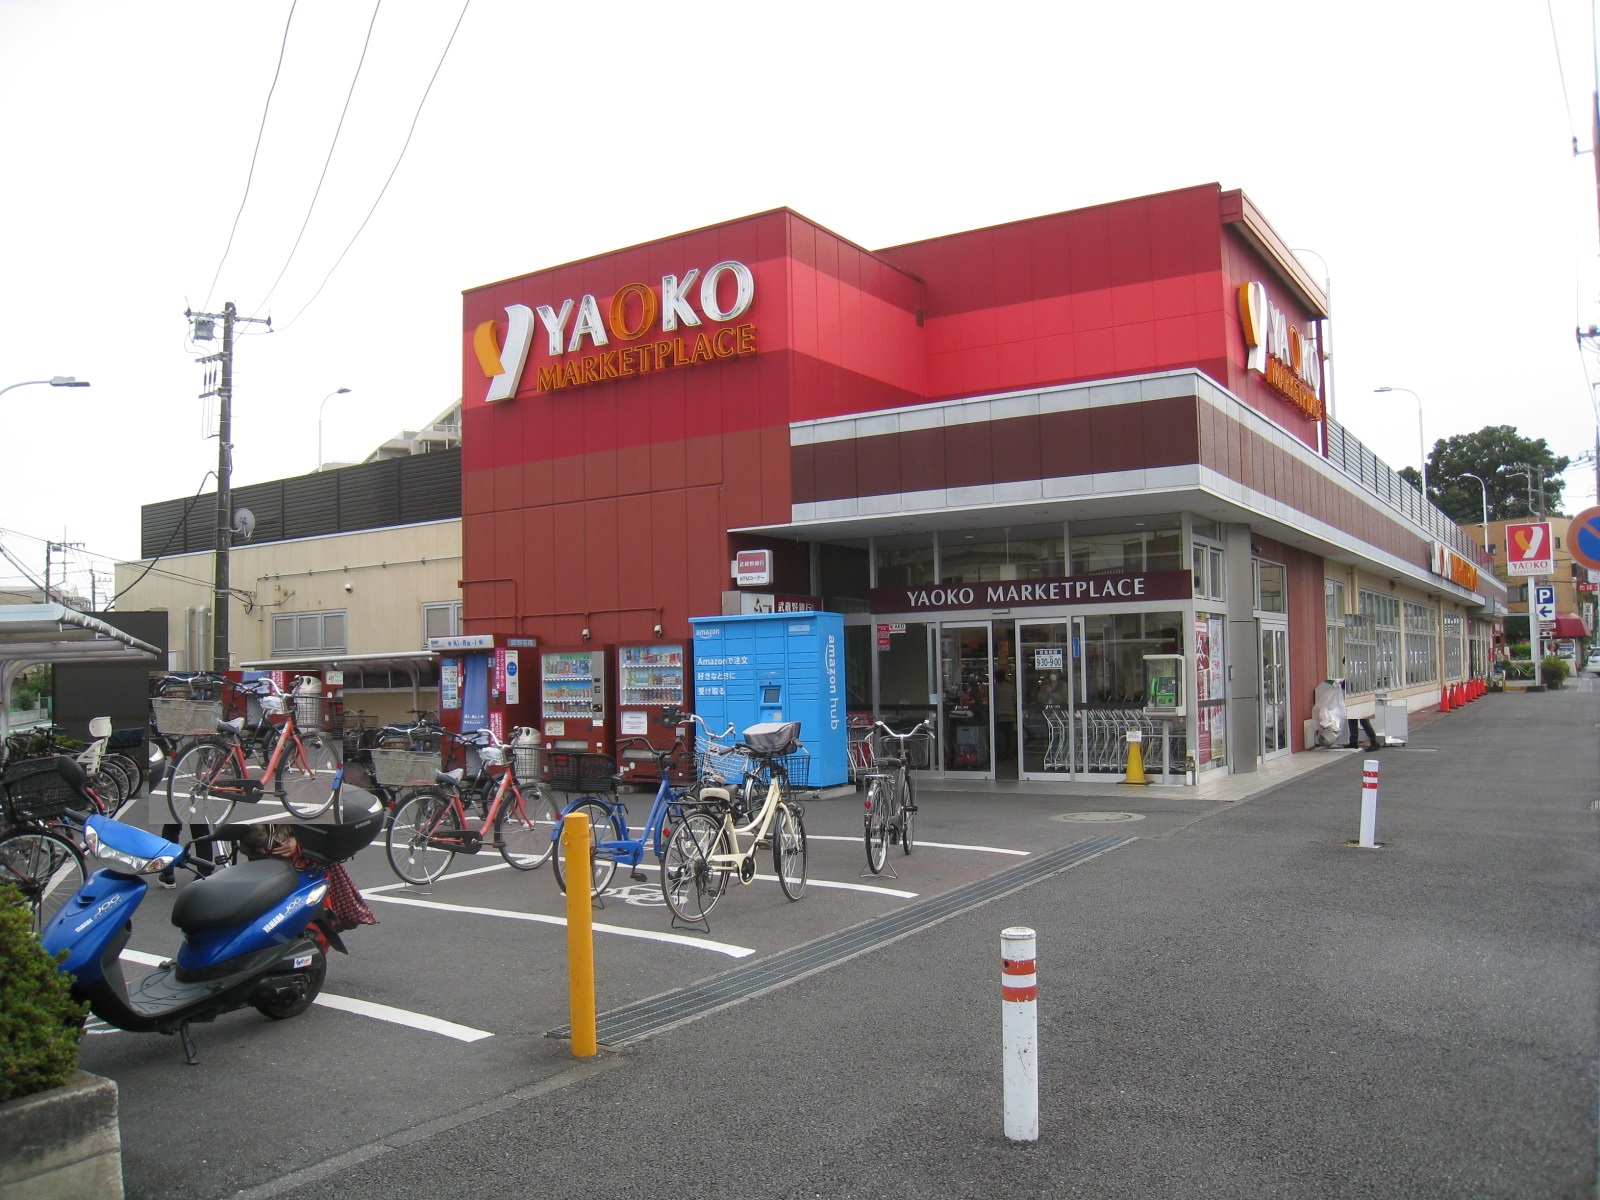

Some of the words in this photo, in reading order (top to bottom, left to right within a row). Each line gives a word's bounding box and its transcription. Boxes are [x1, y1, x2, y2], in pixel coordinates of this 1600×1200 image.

[536, 260, 755, 357] YAOKO
[536, 323, 757, 393] MARKETPLACE
[1511, 560, 1548, 570] YAOKO
[739, 574, 766, 582] ATMコーナー
[906, 587, 975, 607] YAOKO
[986, 577, 1145, 603] MARKETPLACE
[1539, 589, 1551, 604] P
[777, 601, 813, 613] 武蔵野銀行
[695, 628, 720, 637] amazon
[697, 655, 748, 666] Amazonで注文
[826, 634, 837, 694] amazon
[697, 672, 736, 681] 好きなときに
[697, 687, 726, 696] 受け取る
[829, 697, 840, 730] hub
[94, 893, 120, 918] JOG
[284, 896, 302, 915] JOG
[262, 912, 286, 934] YAMAHA
